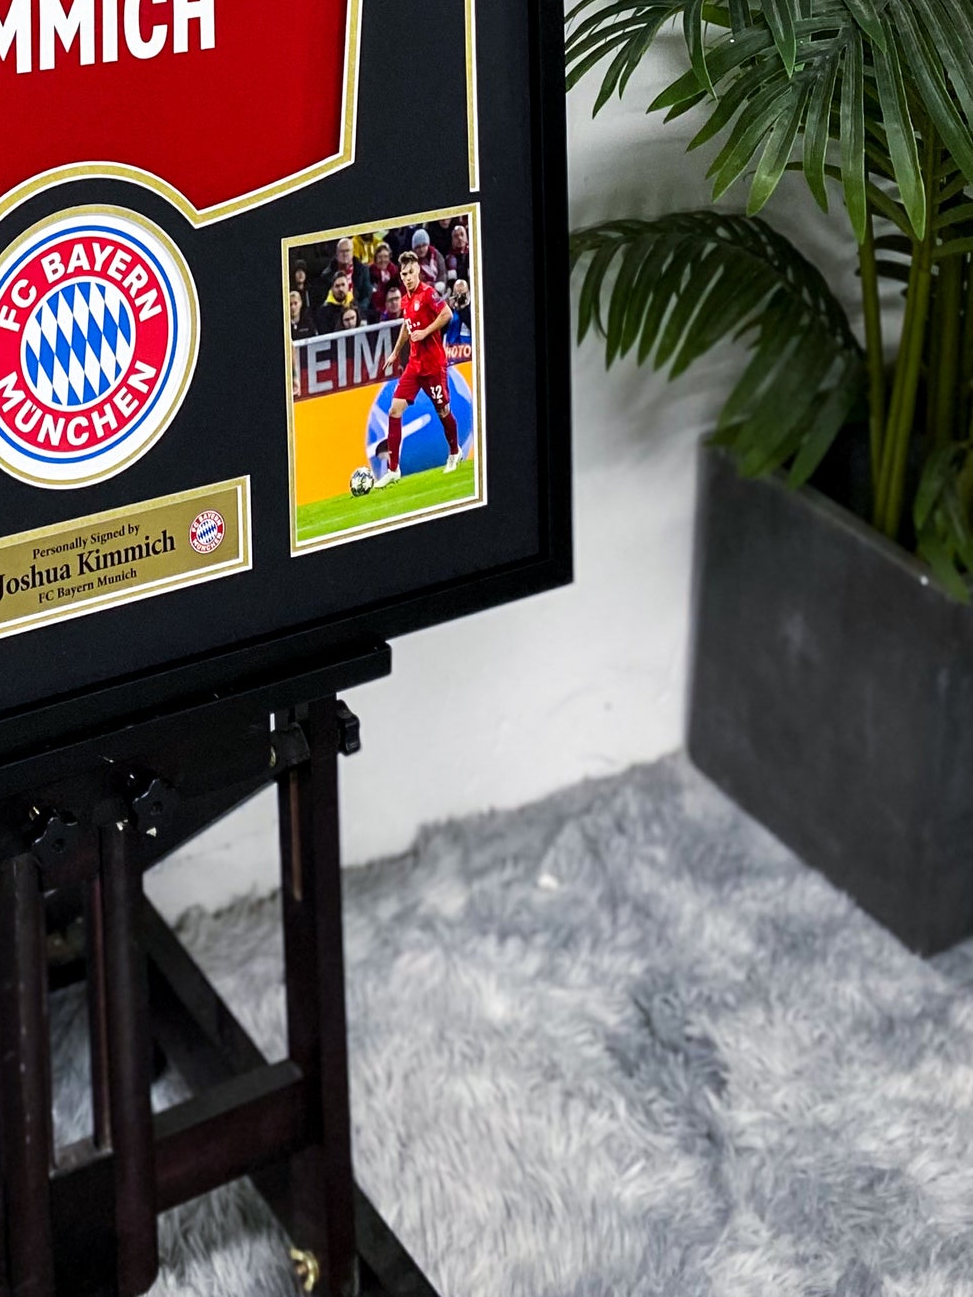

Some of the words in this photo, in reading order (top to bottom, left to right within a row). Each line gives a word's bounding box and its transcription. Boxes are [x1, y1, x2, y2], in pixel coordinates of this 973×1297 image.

[41, 242, 162, 322] BAYERN
[295, 327, 394, 394] EIM
[32, 537, 88, 560] Personally
[90, 526, 126, 544] Signed
[128, 523, 140, 536] by
[77, 529, 176, 576] Kimmich
[38, 590, 55, 604] FC
[57, 581, 94, 599] Bayern
[97, 567, 138, 588] Munich
